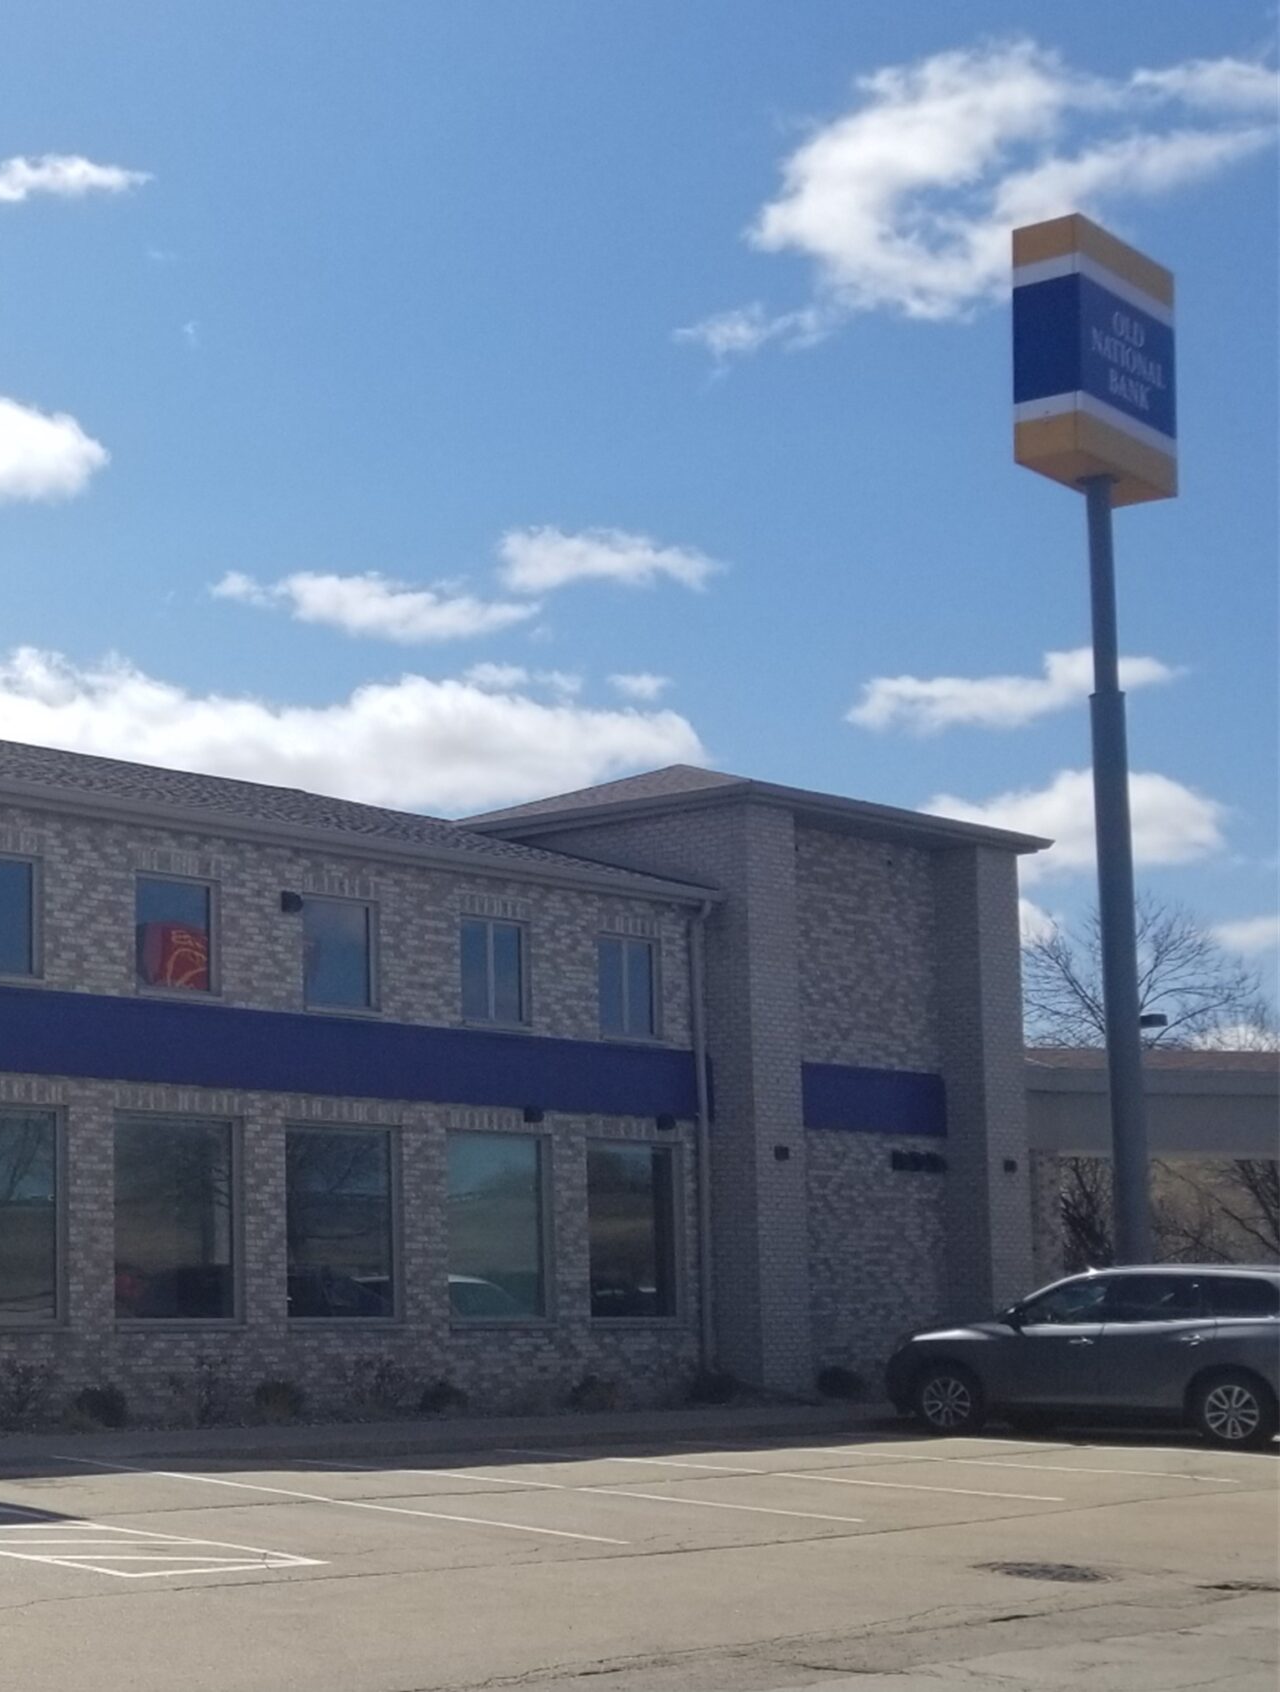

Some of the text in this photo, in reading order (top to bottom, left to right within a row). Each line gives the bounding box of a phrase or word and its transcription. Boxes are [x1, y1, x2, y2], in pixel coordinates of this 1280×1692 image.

[1112, 311, 1145, 348] OLD
[1091, 326, 1166, 390] NATIONAL
[1109, 367, 1150, 411] BANK
